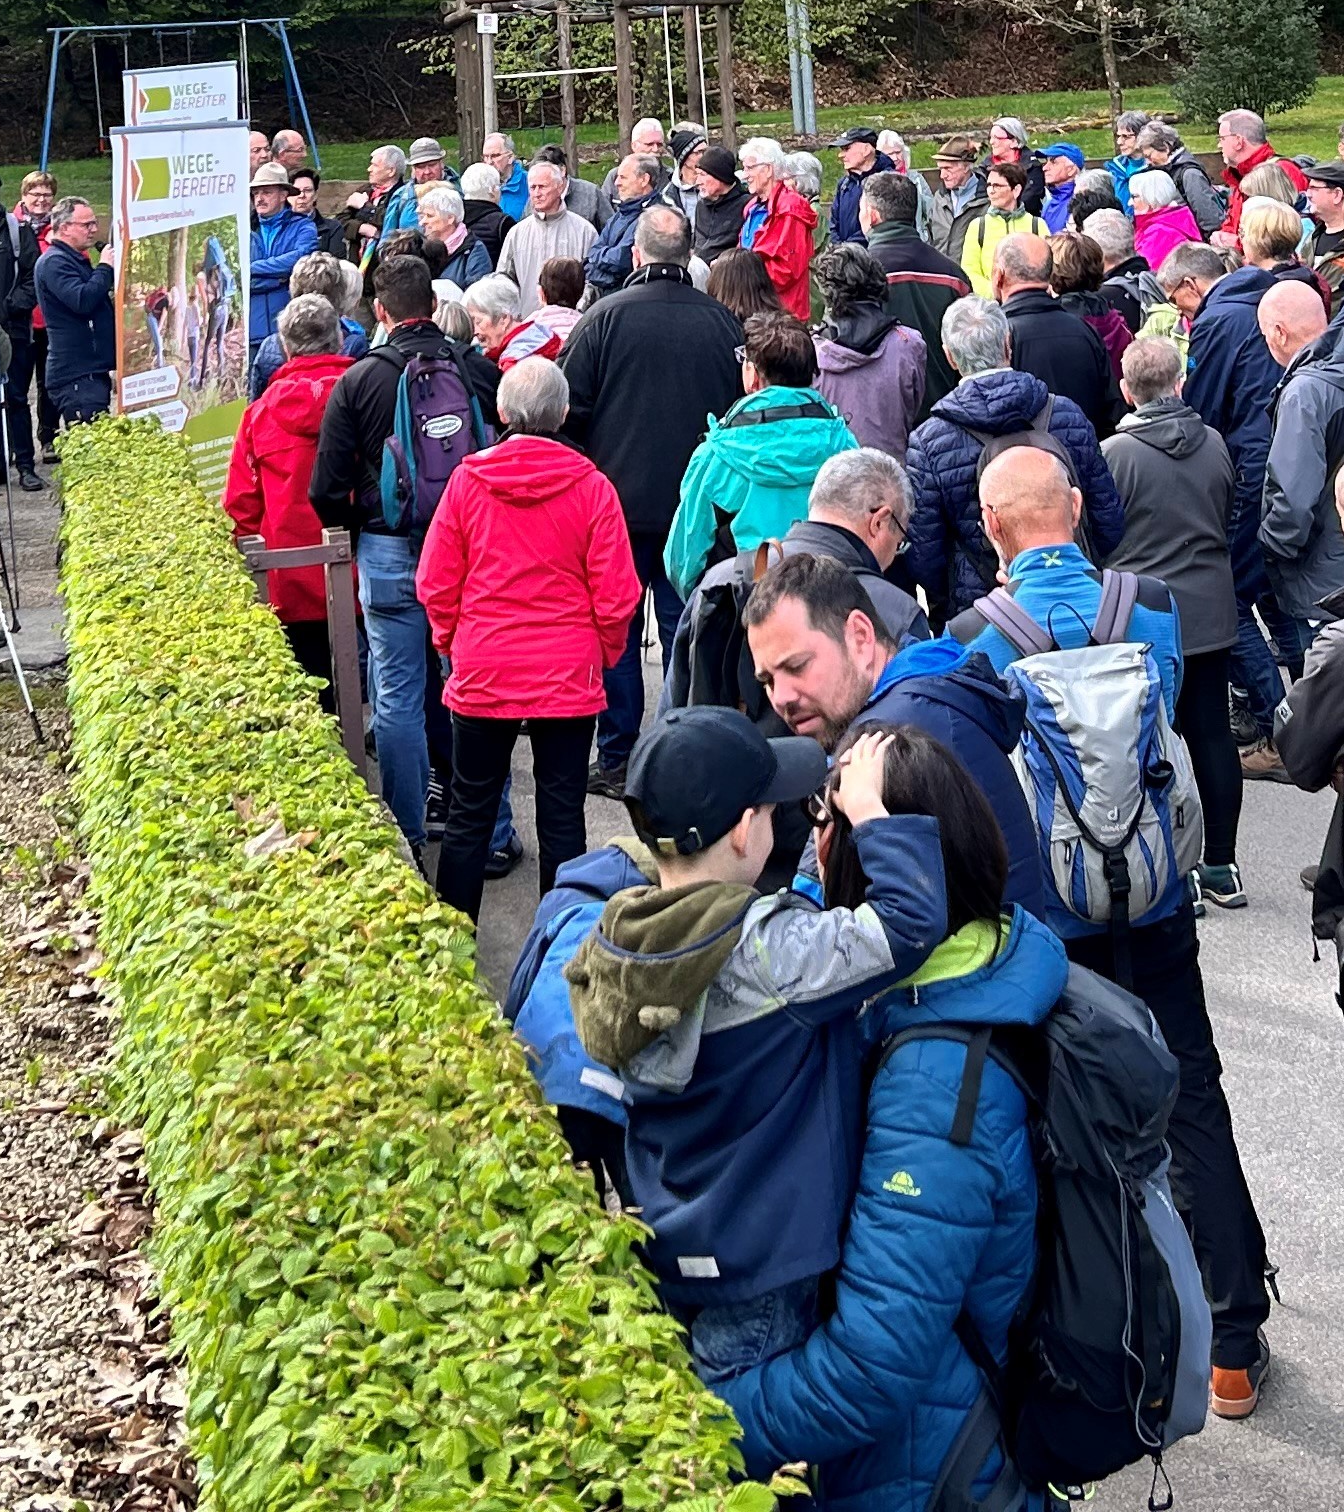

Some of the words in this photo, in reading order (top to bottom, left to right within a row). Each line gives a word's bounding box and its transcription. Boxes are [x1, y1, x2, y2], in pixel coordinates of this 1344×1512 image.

[172, 82, 213, 97] WEGE-
[173, 94, 226, 110] BEREITER
[172, 153, 220, 175] WEGE-
[172, 174, 236, 199] BEREITER
